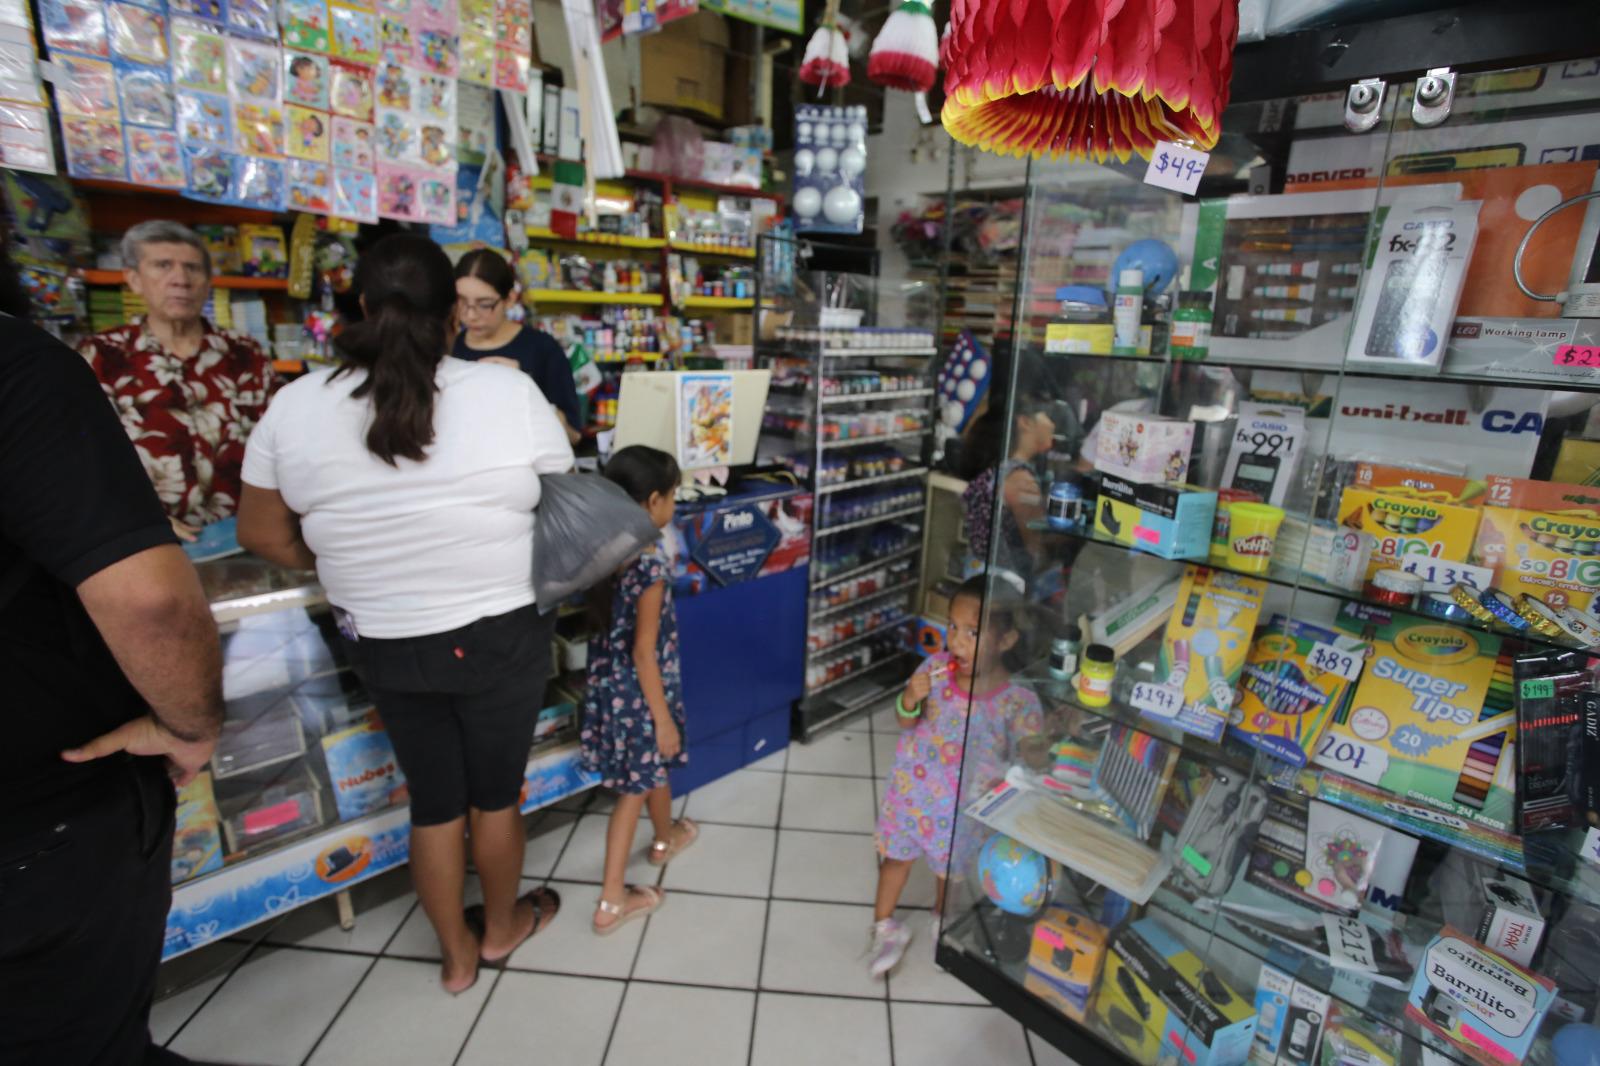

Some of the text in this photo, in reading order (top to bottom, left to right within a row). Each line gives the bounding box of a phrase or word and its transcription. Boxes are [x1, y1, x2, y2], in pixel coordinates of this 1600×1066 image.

[1485, 327, 1567, 340] Working lamp
[1562, 346, 1600, 366] $2
[1251, 420, 1288, 432] CASIO
[1491, 484, 1512, 500] 12
[1374, 498, 1438, 518] Crayola
[1548, 592, 1565, 606] 12
[1408, 633, 1464, 646] Crayola
[1314, 647, 1353, 676] $89
[1372, 656, 1468, 699] Super
[1411, 689, 1475, 725] Tips
[1399, 730, 1421, 747] 20
[1456, 805, 1474, 818] 24
[1504, 922, 1526, 951] TRAK
[1447, 947, 1529, 997] Barrilito
[1432, 963, 1516, 1019] Barrilito
